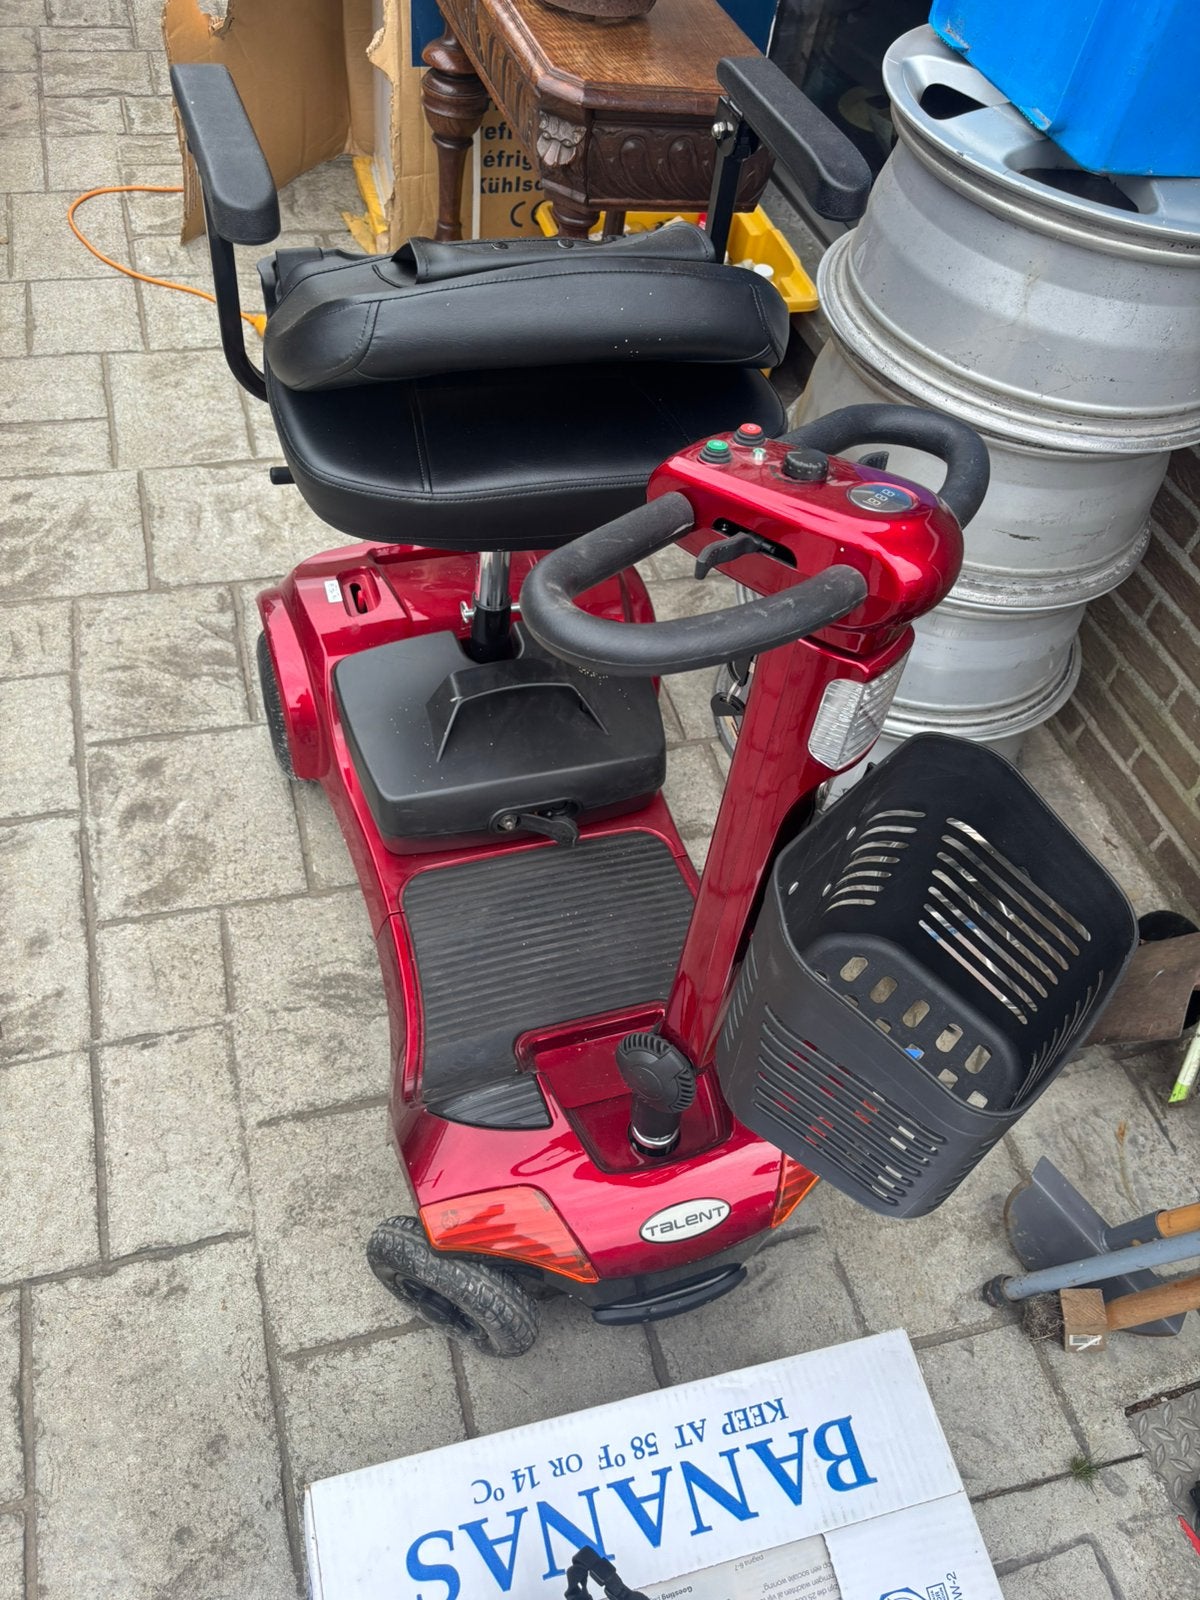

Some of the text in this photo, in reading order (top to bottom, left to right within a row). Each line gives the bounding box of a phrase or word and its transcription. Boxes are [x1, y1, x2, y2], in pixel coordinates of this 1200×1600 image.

[722, 1397, 788, 1436] KEEP
[630, 1432, 659, 1460] 58
[675, 1418, 706, 1449] AT
[511, 1464, 540, 1494] 14
[548, 1453, 584, 1478] OR
[405, 1415, 878, 1600] BANANAS
[661, 1585, 693, 1600] Goesting
